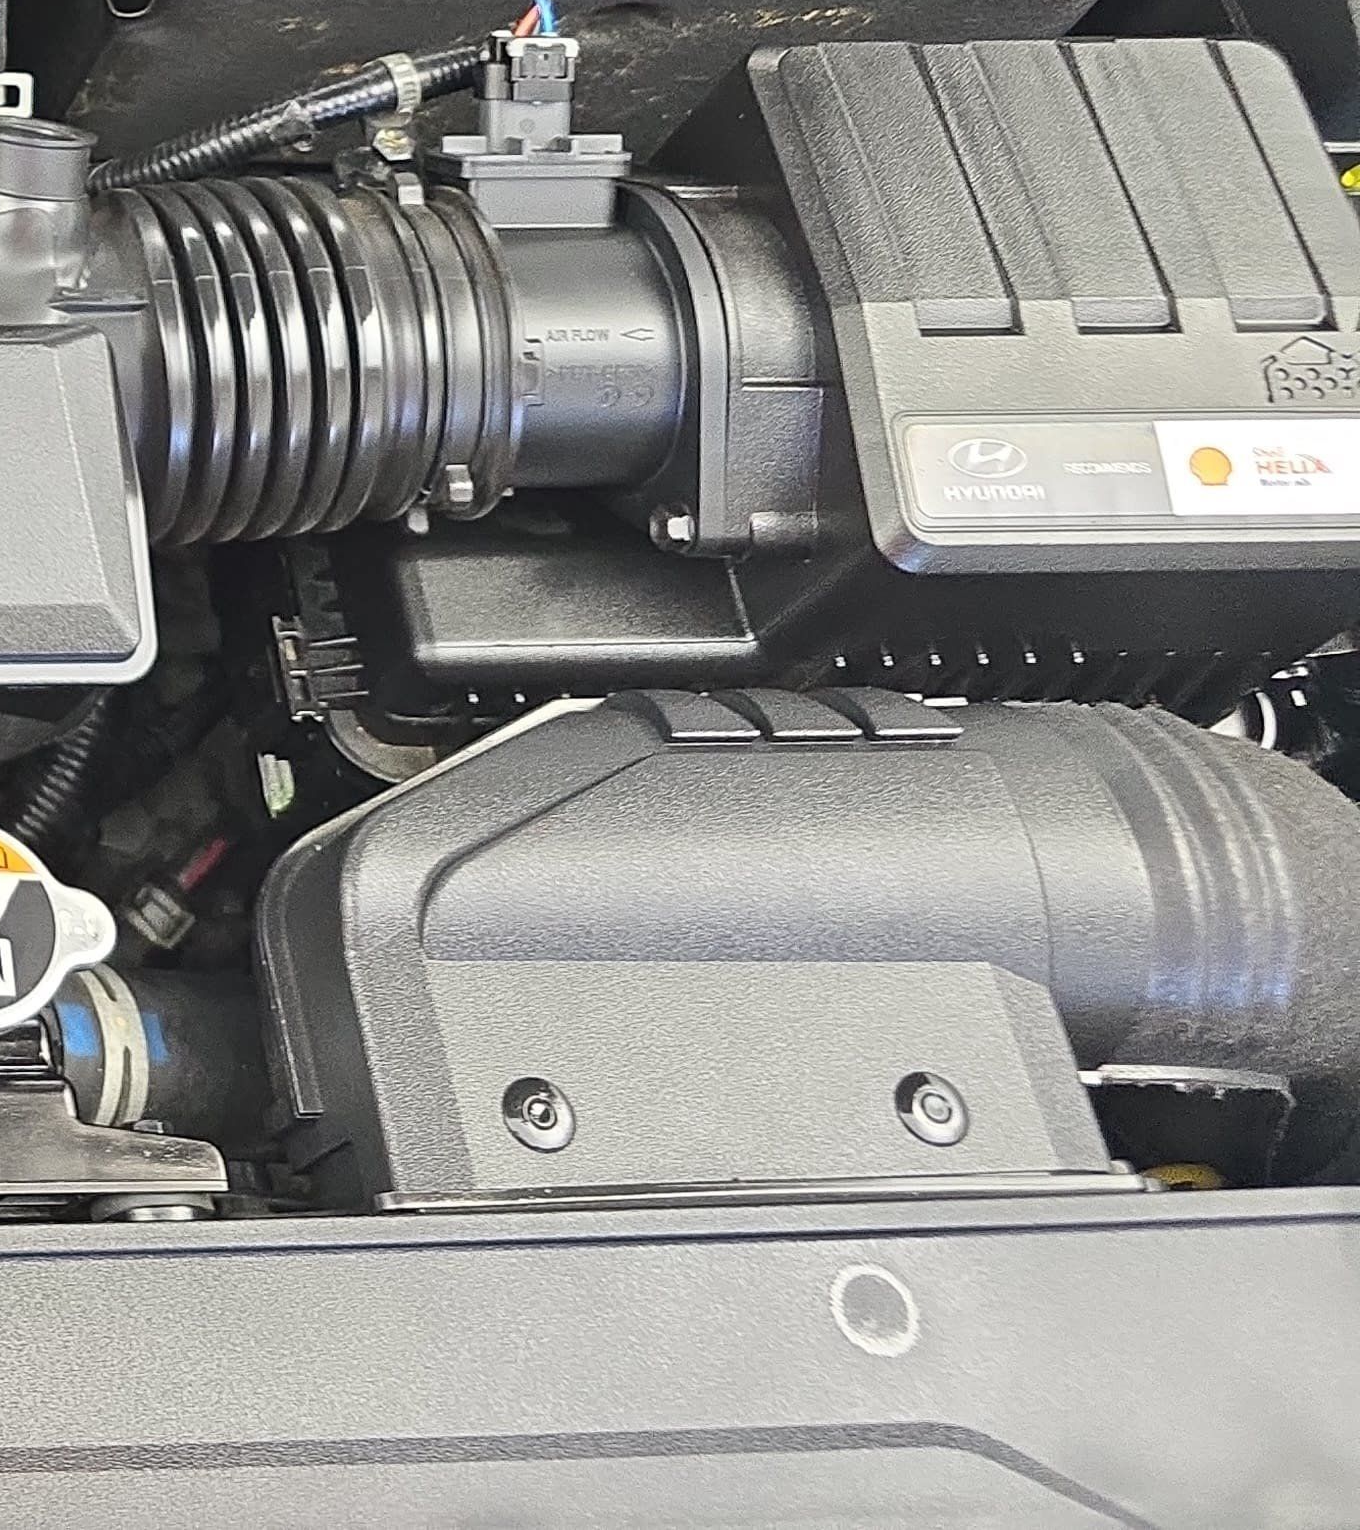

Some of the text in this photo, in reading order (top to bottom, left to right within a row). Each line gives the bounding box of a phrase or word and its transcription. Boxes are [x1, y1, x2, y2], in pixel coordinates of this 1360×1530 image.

[546, 327, 610, 342] AIR FLOW
[942, 484, 1046, 502] HYUNDAI
